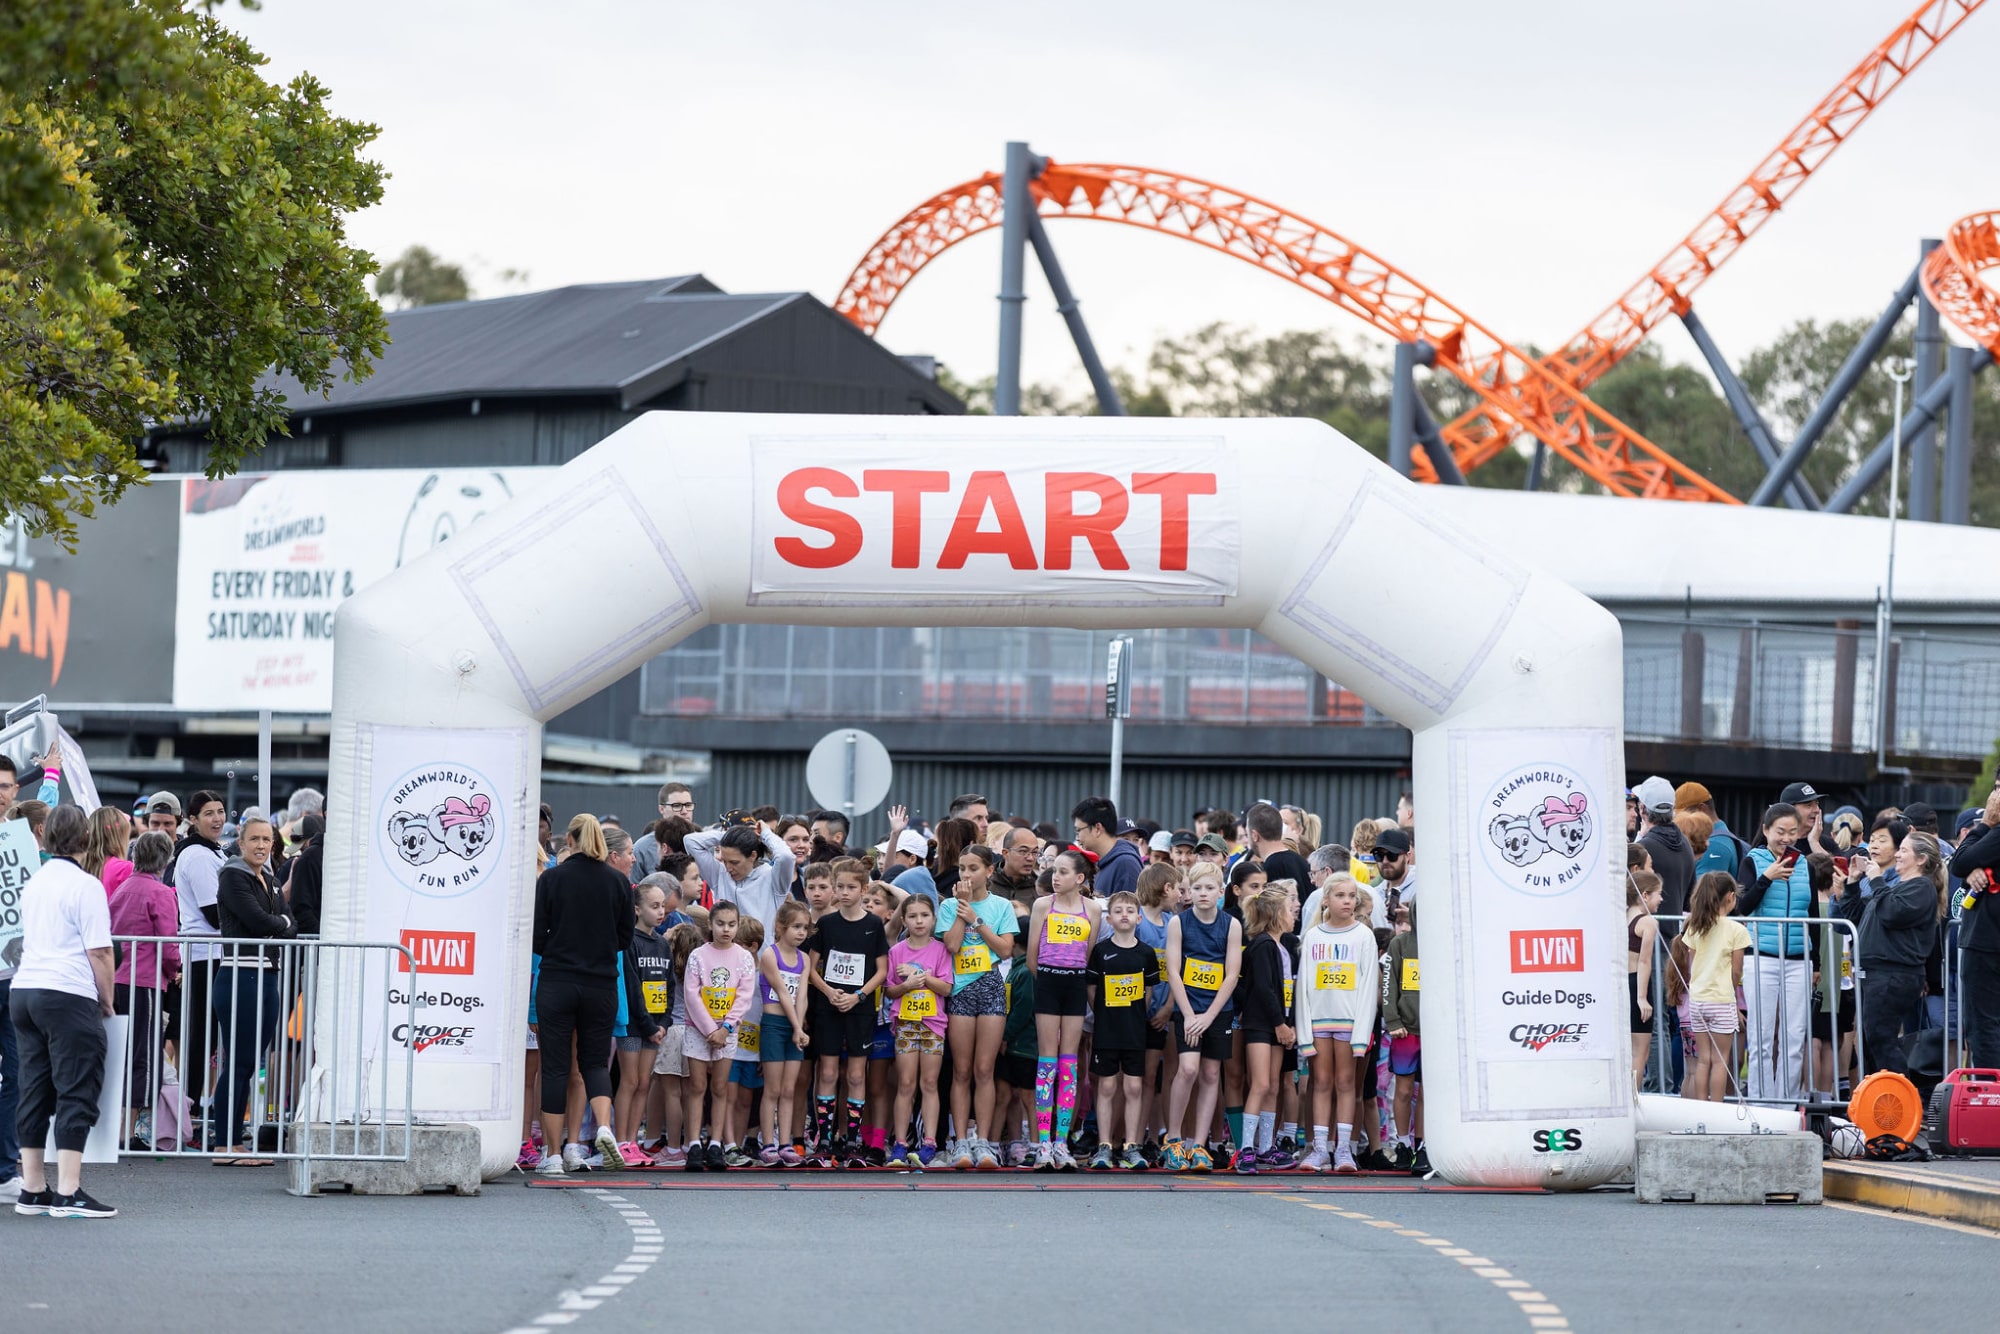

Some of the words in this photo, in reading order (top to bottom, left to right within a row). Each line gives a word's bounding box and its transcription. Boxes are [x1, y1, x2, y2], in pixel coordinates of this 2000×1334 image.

[774, 467, 1217, 571] START
[244, 515, 325, 551] DREAMWORLD
[212, 571, 266, 598] EVERY
[272, 571, 335, 598] FRIDAY
[342, 570, 354, 598] &
[207, 612, 296, 639] SATURDAY
[393, 771, 478, 805] DREAMWORLD'S
[1492, 771, 1574, 808] DREAMWORLD'S
[419, 873, 446, 888] FUN
[453, 865, 480, 886] RUN
[1525, 873, 1551, 887] FUN
[1558, 863, 1581, 884] RUN
[1056, 924, 1082, 936] 2298
[408, 937, 467, 967] LIVIN
[1519, 937, 1577, 965] LIVIN
[638, 956, 671, 969] EVERLT
[832, 963, 855, 976] 4015
[960, 957, 982, 969] 2547
[1191, 971, 1217, 985] 2450
[1323, 974, 1347, 985] 2552
[388, 989, 438, 1006] Gude
[440, 991, 484, 1013] Dogs.
[1115, 985, 1138, 997] 2297
[1502, 990, 1552, 1006] Guide
[1554, 989, 1596, 1009] Dogs.
[709, 999, 731, 1010] 2526
[907, 1000, 930, 1012] 2548
[391, 1023, 476, 1043] CHOICE
[1509, 1023, 1590, 1043] CHOICE
